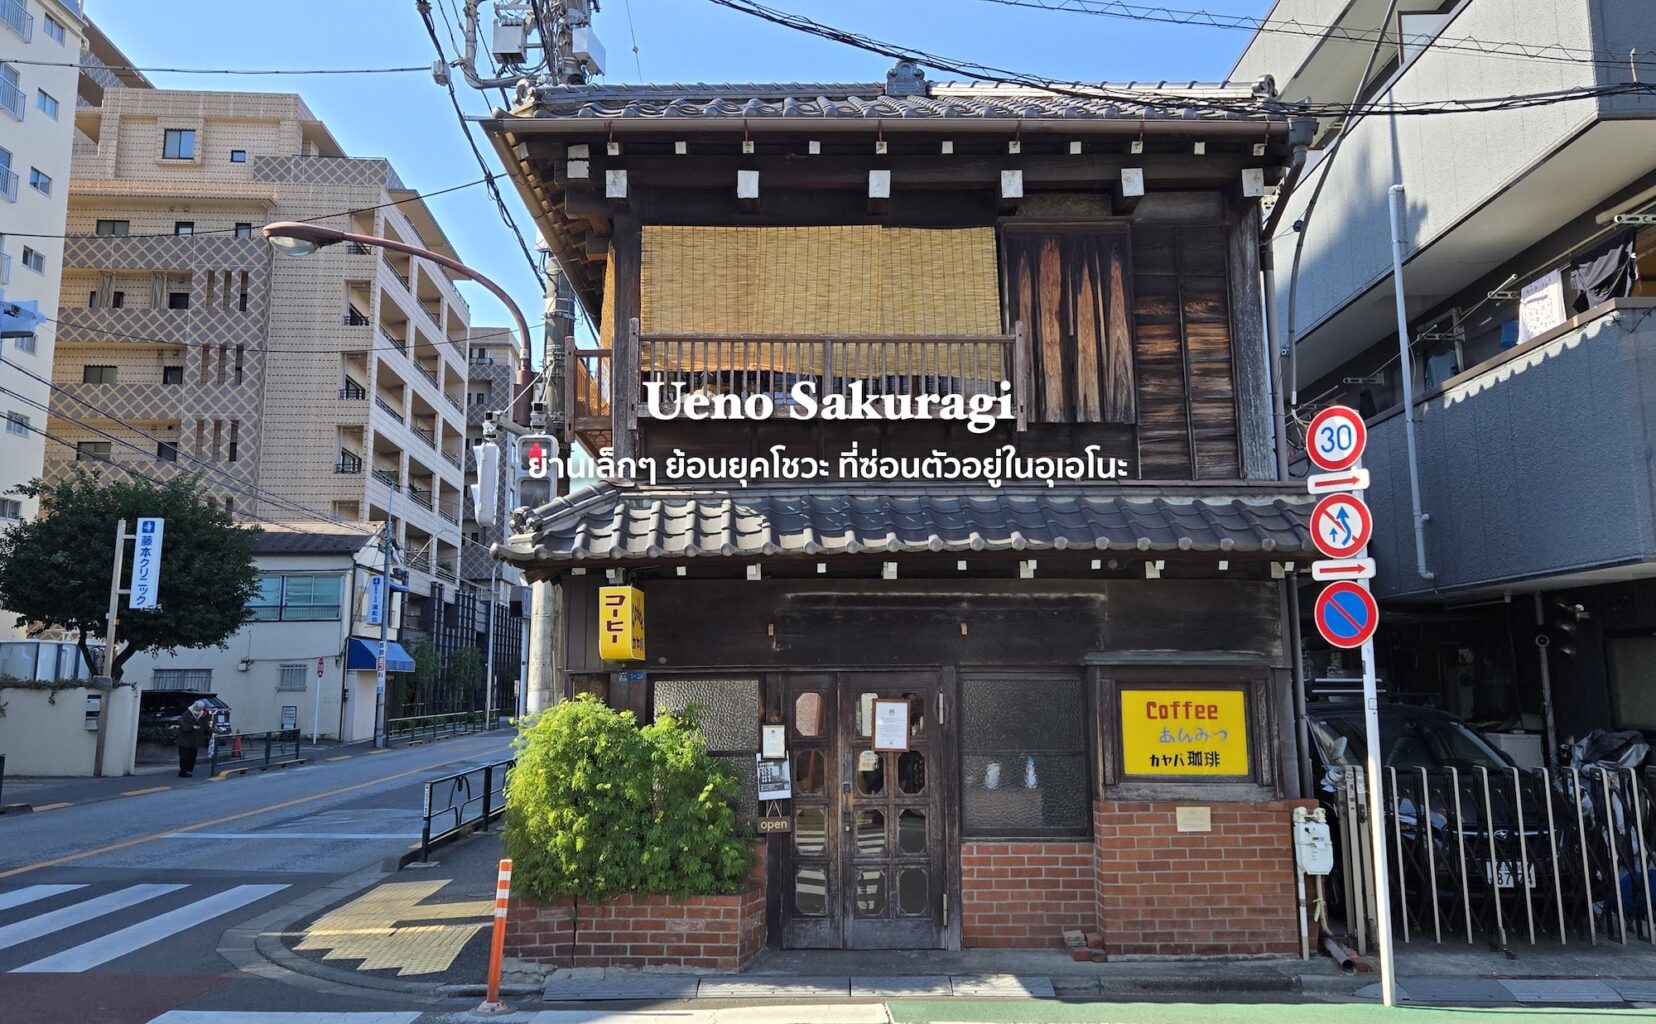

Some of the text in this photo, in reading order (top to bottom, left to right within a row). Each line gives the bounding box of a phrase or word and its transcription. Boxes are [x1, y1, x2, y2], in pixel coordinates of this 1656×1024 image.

[1321, 424, 1352, 453] 30
[136, 535, 153, 606] 藤本クリニック
[605, 595, 626, 644] コーヒー
[1146, 701, 1218, 720] Coffee
[1159, 726, 1229, 743] あんみつ
[760, 820, 788, 832] open
